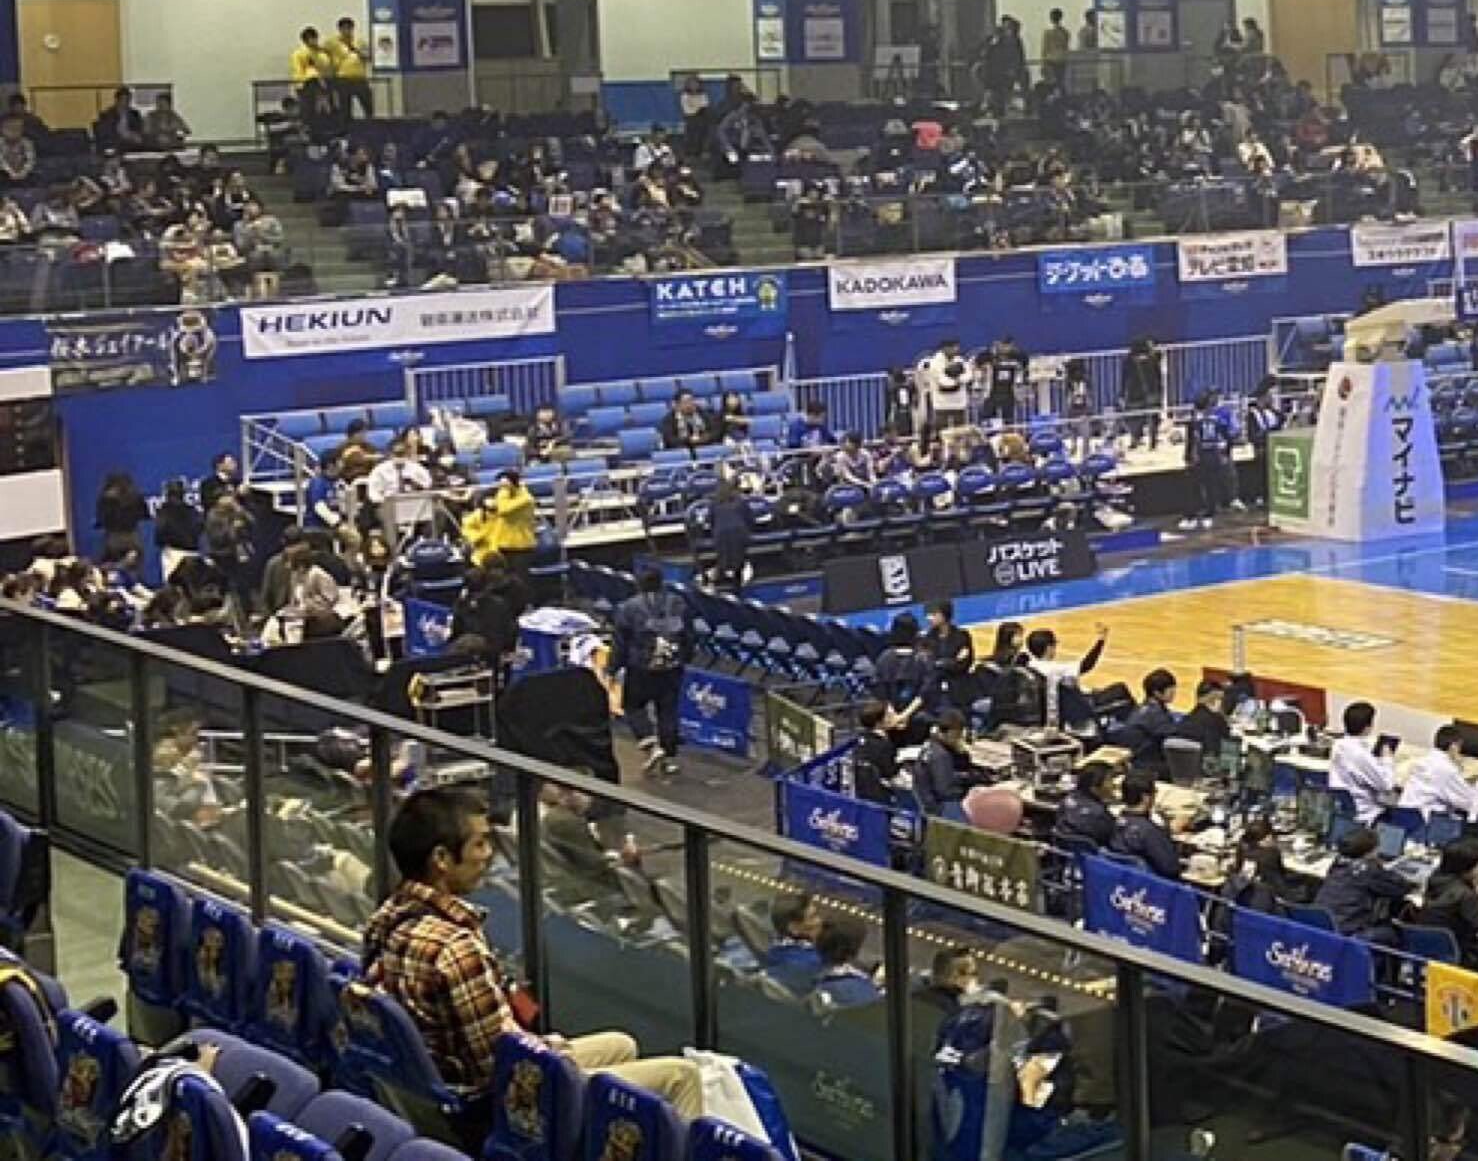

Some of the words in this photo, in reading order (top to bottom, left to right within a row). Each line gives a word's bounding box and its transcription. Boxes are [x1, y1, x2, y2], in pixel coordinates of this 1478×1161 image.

[1044, 259, 1150, 285] チケットぴあ
[655, 277, 749, 300] KATCH
[835, 274, 950, 297] KADOKAWA
[257, 307, 394, 335] HEKIUN
[1391, 416, 1417, 525] マイナビ
[986, 538, 1065, 566] バスケット
[1016, 559, 1063, 582] LIVE
